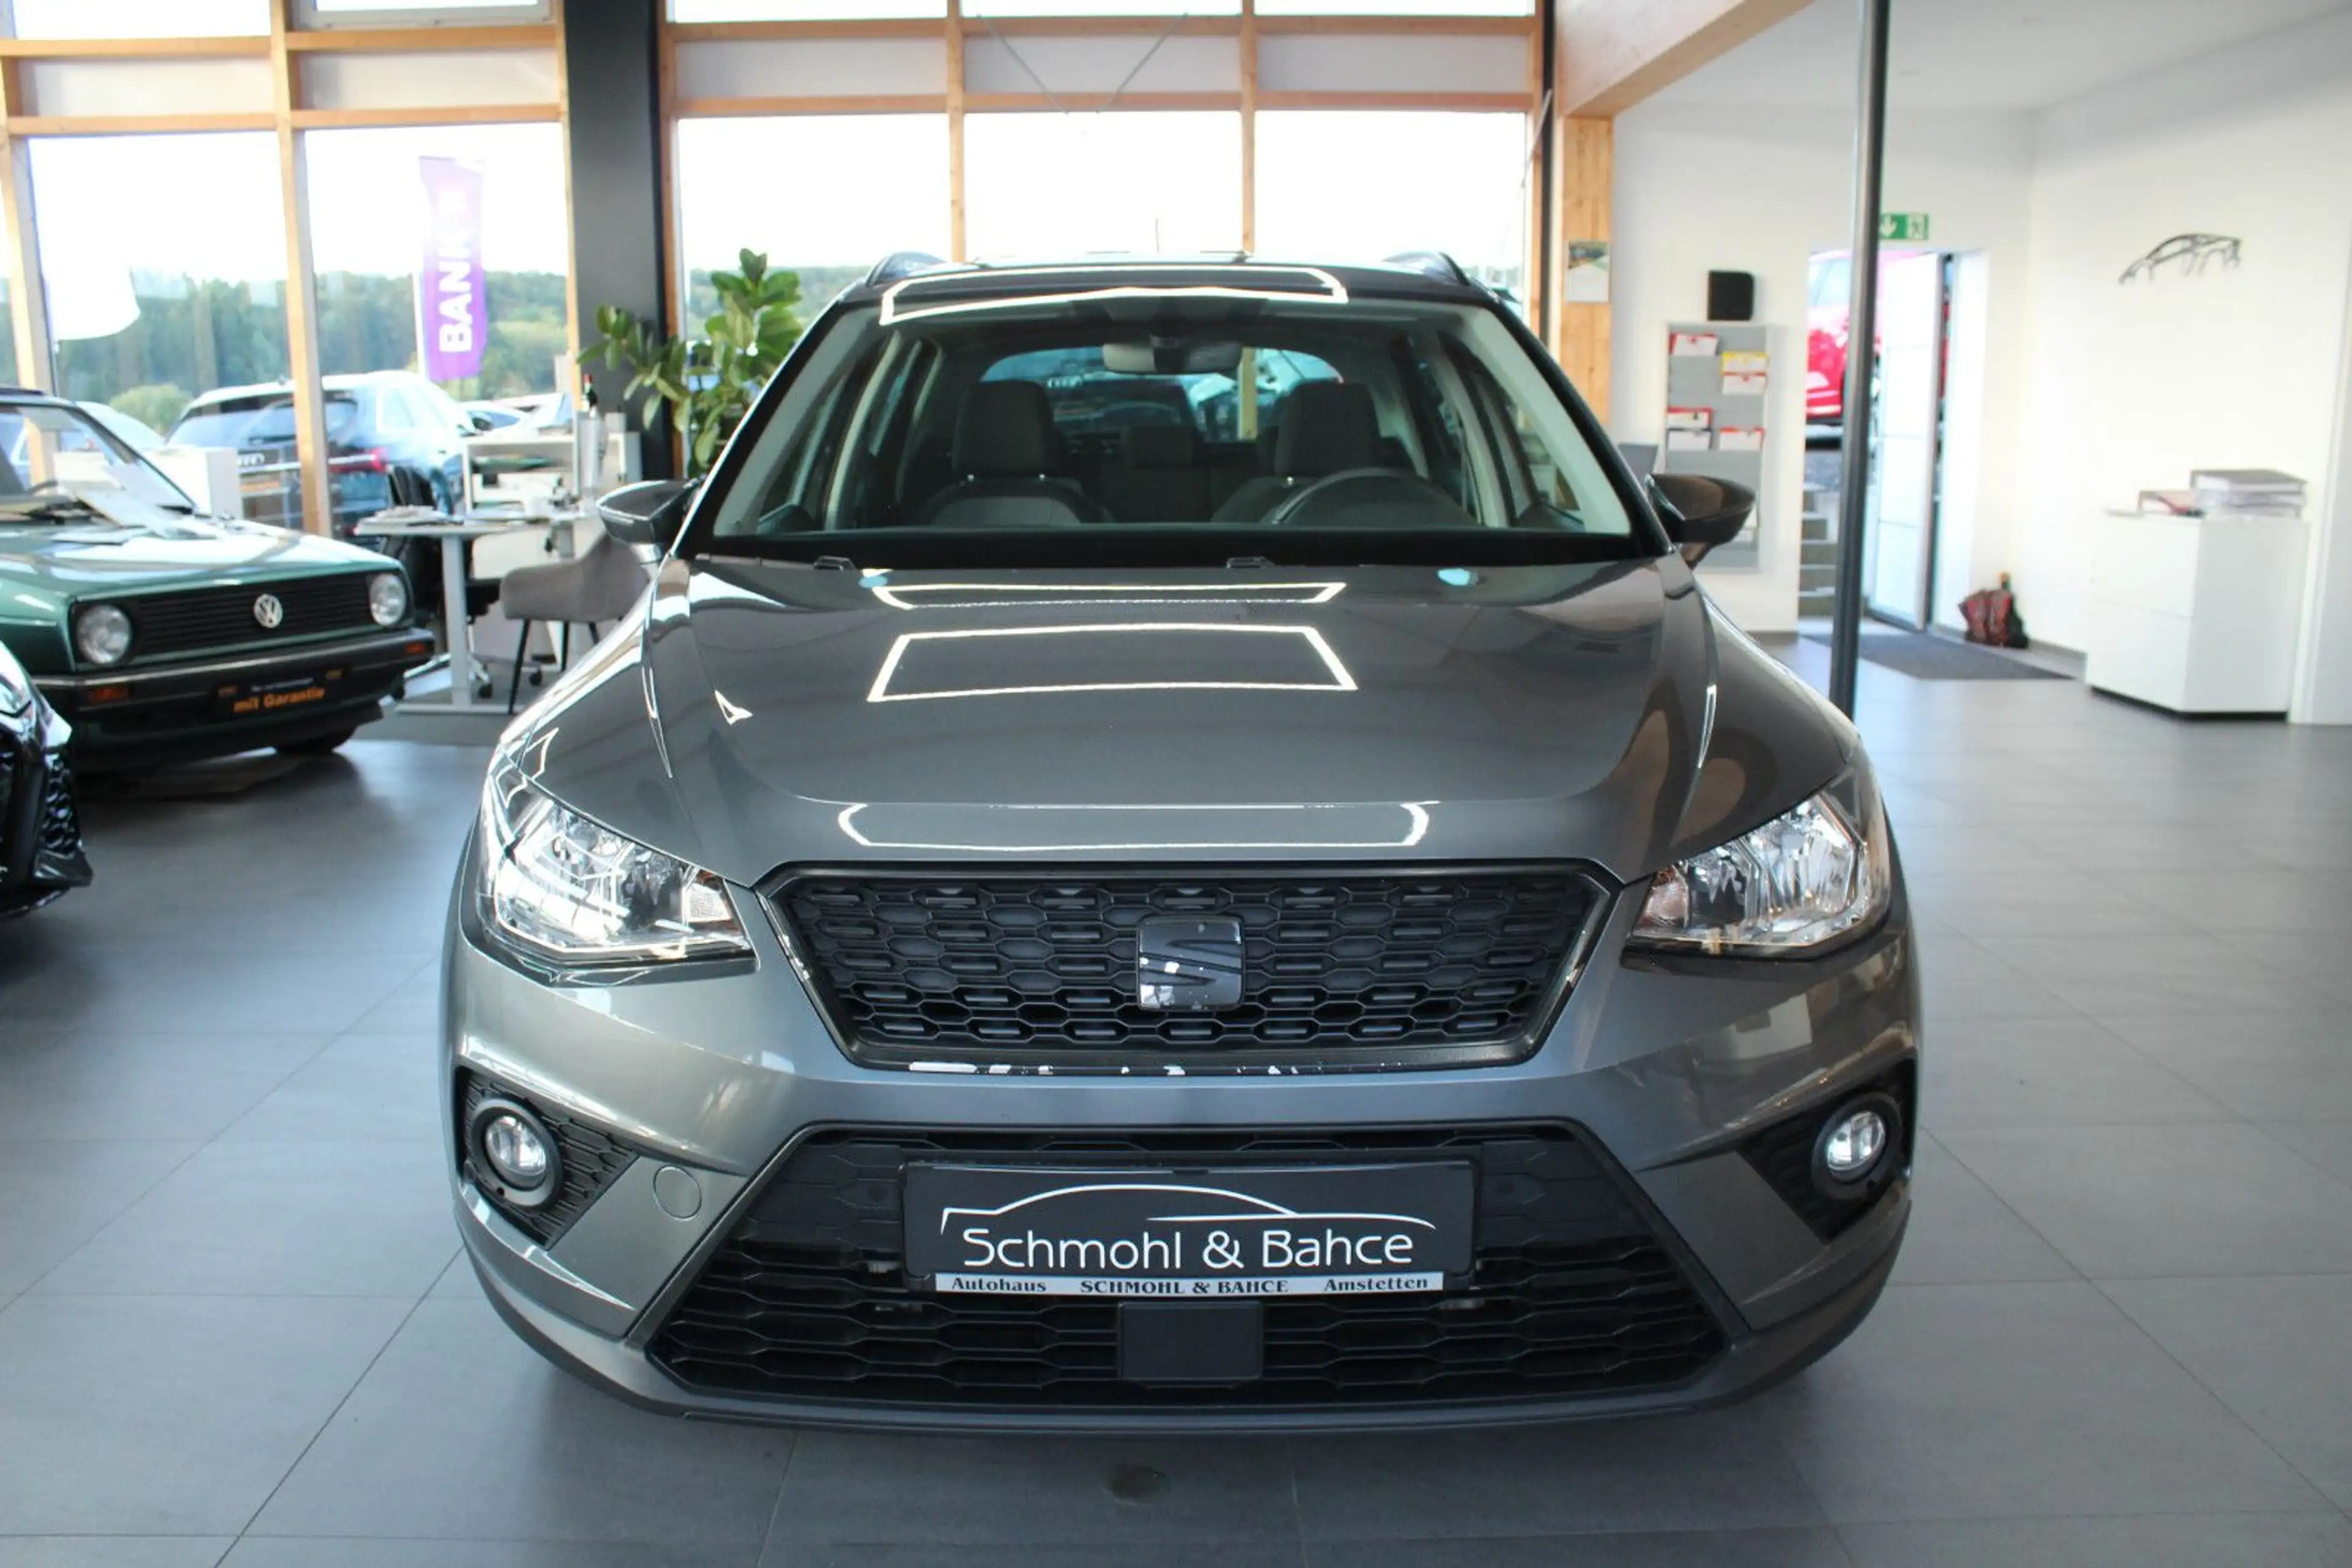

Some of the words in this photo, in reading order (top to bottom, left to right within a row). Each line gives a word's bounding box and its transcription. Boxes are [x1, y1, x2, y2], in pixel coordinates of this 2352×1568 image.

[963, 1227, 1182, 1269] Schmohl
[1202, 1230, 1244, 1269] &
[1262, 1228, 1413, 1268] Bahce
[952, 1276, 1046, 1292] Autohaus
[1080, 1280, 1185, 1294] SCHMOHL
[1193, 1281, 1210, 1294] &
[1218, 1280, 1288, 1294] BAHCE
[1324, 1276, 1428, 1292] Amstetten
